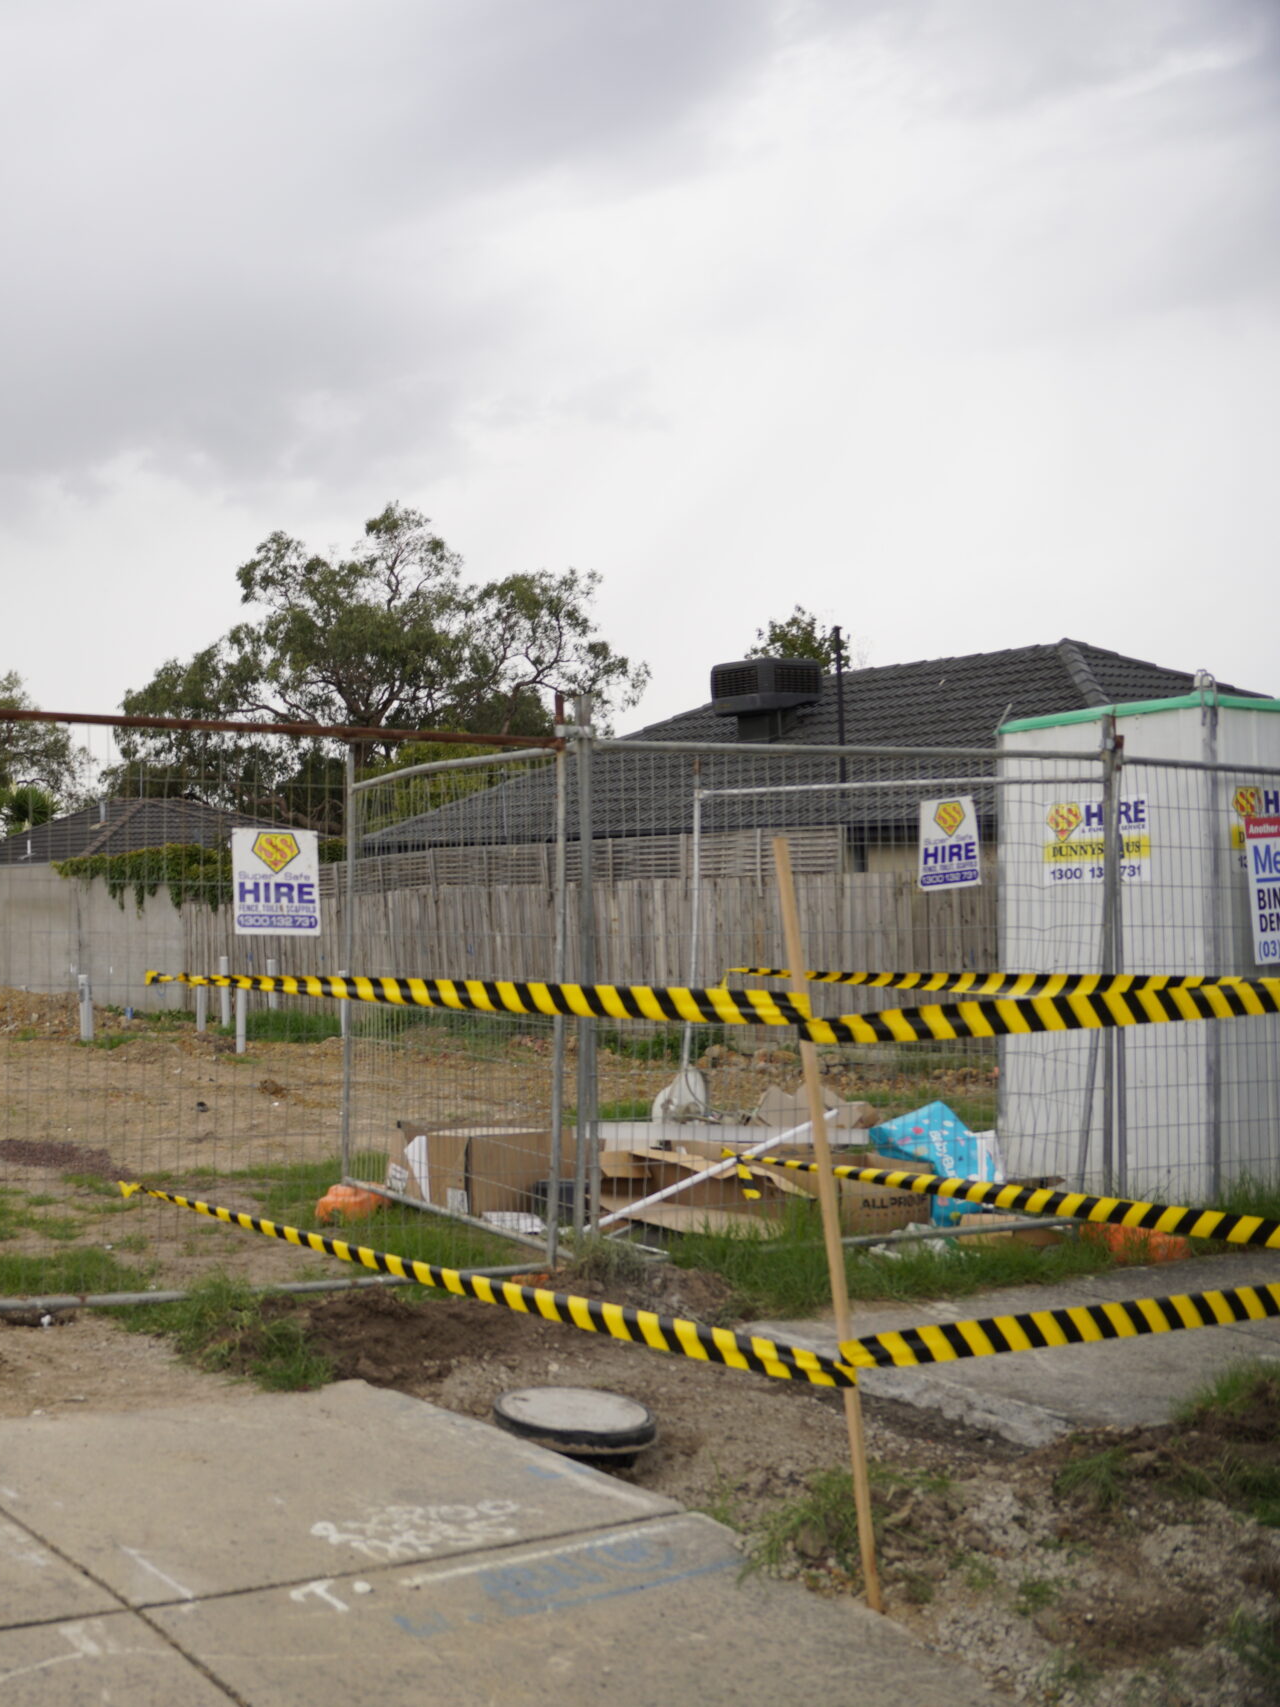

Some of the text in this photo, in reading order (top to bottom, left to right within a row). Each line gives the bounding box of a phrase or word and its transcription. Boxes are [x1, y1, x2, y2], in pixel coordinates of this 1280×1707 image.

[1085, 800, 1146, 826] HRE
[1248, 823, 1279, 835] Another
[923, 842, 977, 865] HIRE
[238, 871, 311, 881] Super Safe
[1050, 864, 1141, 880] 1300 13 731
[922, 874, 944, 885] 1300
[239, 881, 316, 904] HIRE
[238, 915, 316, 927] 1300 132 731
